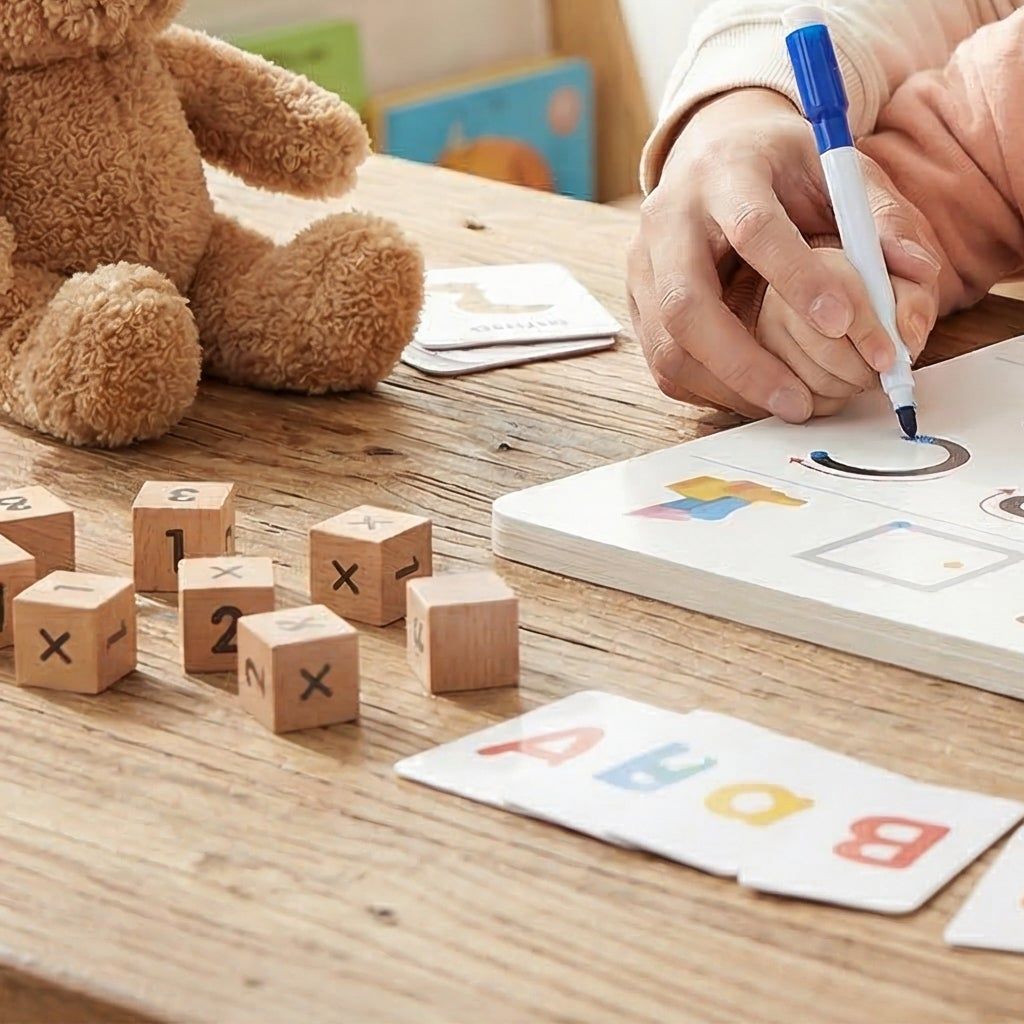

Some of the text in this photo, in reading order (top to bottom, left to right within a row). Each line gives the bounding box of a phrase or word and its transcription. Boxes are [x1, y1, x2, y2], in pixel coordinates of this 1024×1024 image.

[808, 435, 971, 477] C
[165, 529, 184, 574] 1
[211, 605, 243, 654] 2
[832, 815, 951, 869] B
